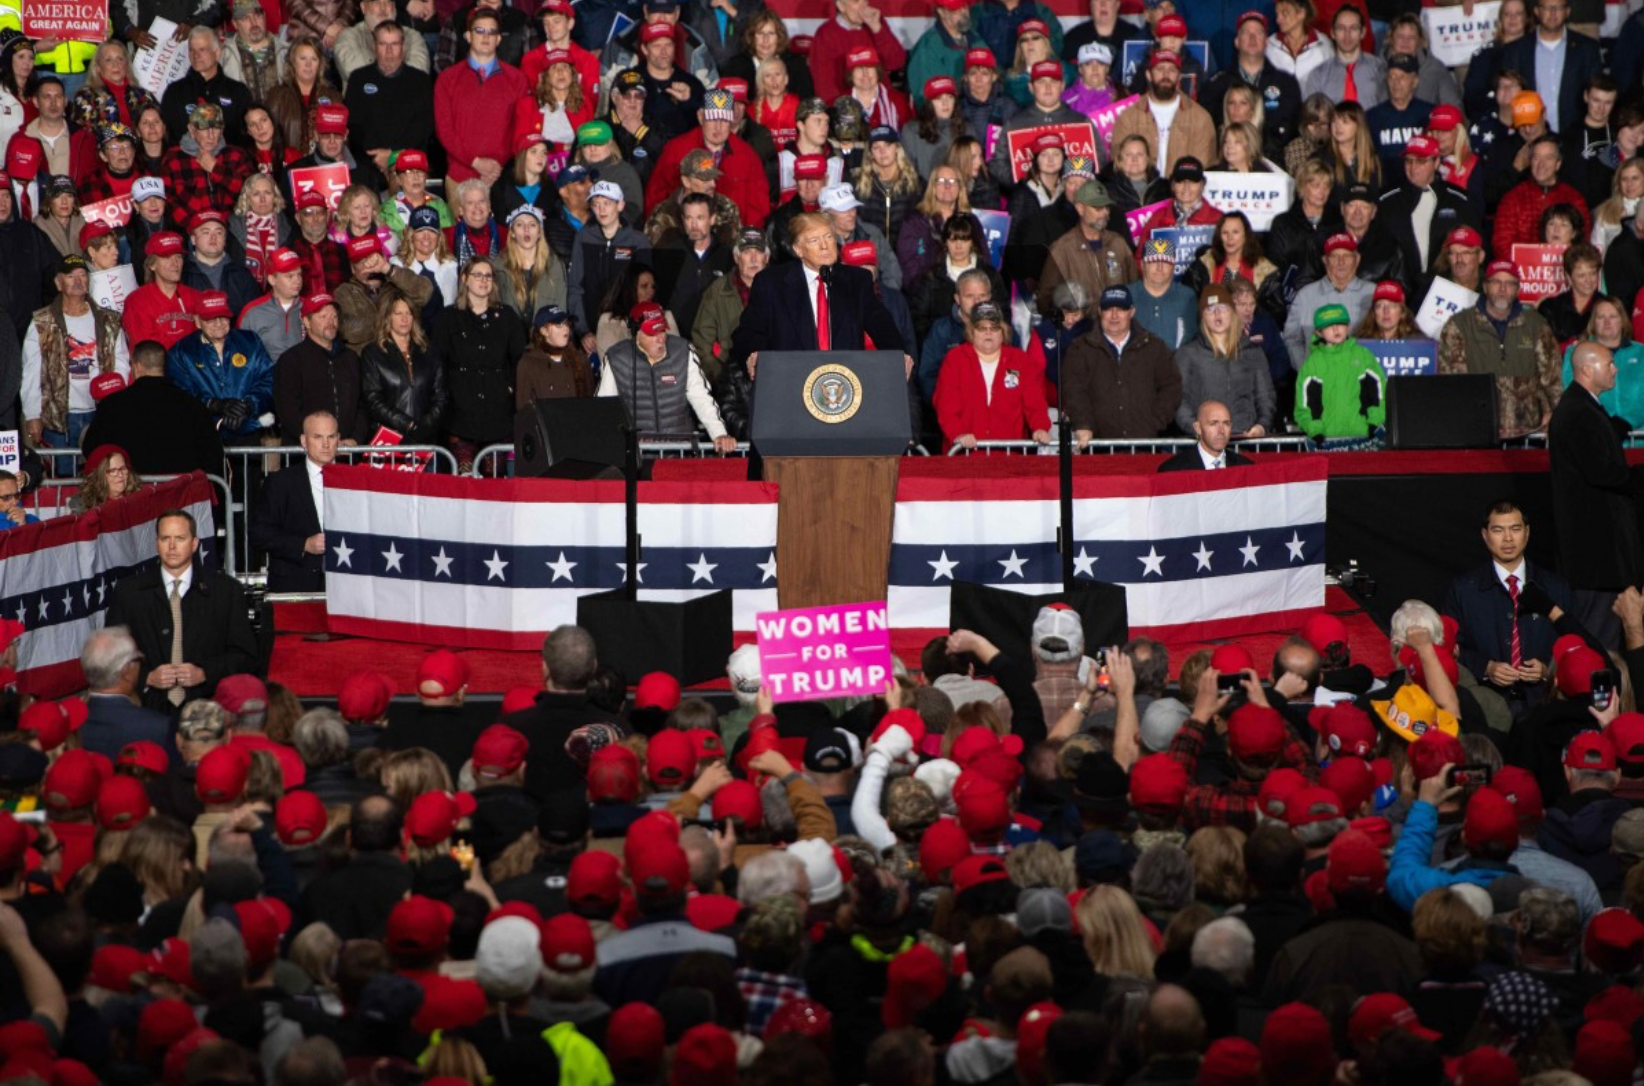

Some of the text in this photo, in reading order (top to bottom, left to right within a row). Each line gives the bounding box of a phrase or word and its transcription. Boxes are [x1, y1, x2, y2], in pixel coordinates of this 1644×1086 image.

[25, 3, 105, 20] AMERICA
[30, 20, 99, 30] GREAT AGAIN
[140, 50, 155, 72] KEE
[140, 180, 159, 190] USA
[1208, 189, 1280, 200] TRUMP
[1215, 201, 1272, 209] PENCE
[1179, 234, 1208, 245] MAKE
[1376, 356, 1430, 369] UMP
[758, 608, 887, 640] WOMEN
[801, 643, 847, 662] FOR
[768, 665, 885, 695] TRUMP
